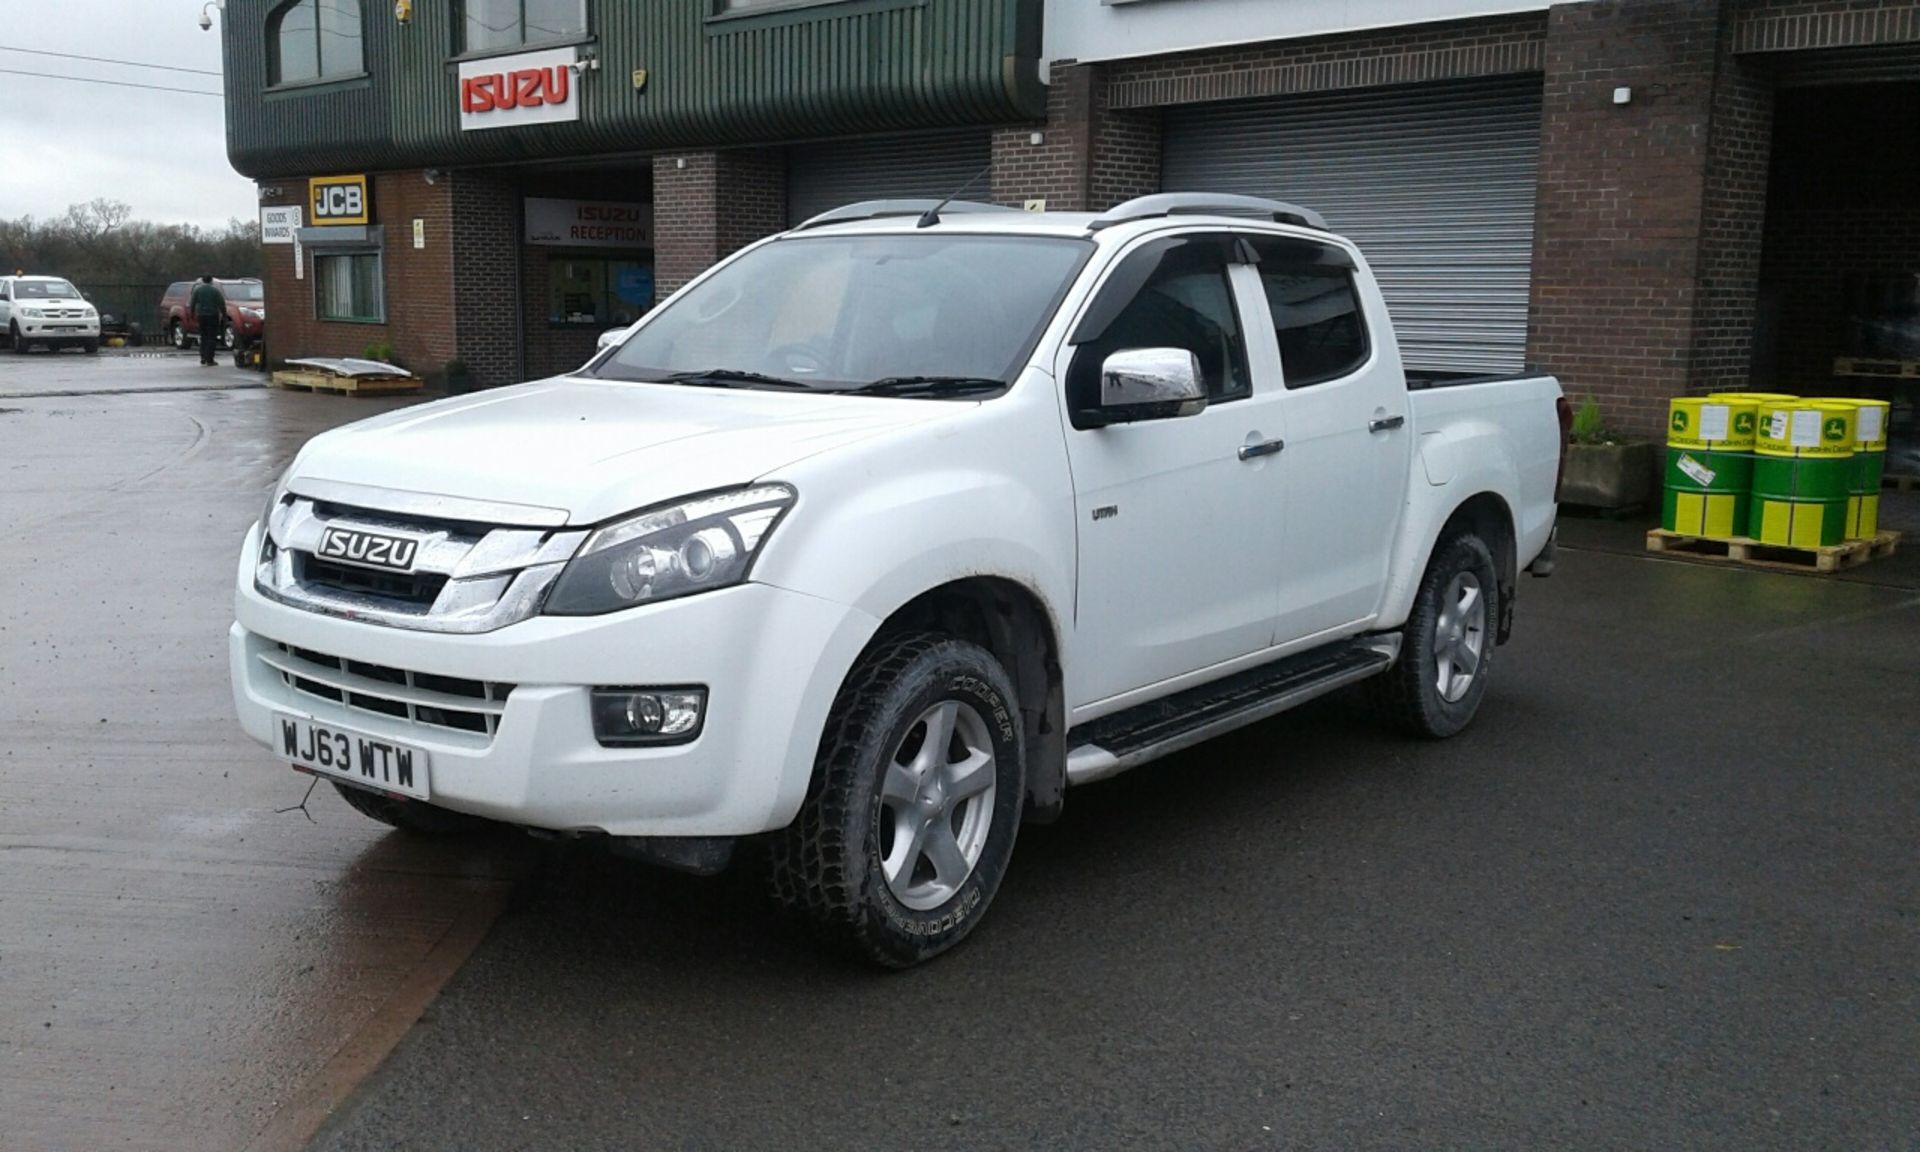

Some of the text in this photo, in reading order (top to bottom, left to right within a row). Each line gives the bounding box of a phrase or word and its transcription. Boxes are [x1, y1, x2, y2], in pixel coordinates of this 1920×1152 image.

[462, 65, 568, 113] ISUZU
[315, 185, 362, 215] JCB
[577, 206, 640, 222] ISUZU
[570, 225, 646, 240] RECEPTION
[320, 529, 415, 566] ISUZU
[948, 675, 1014, 742] COOPER
[282, 719, 413, 788] WJ63 WTW
